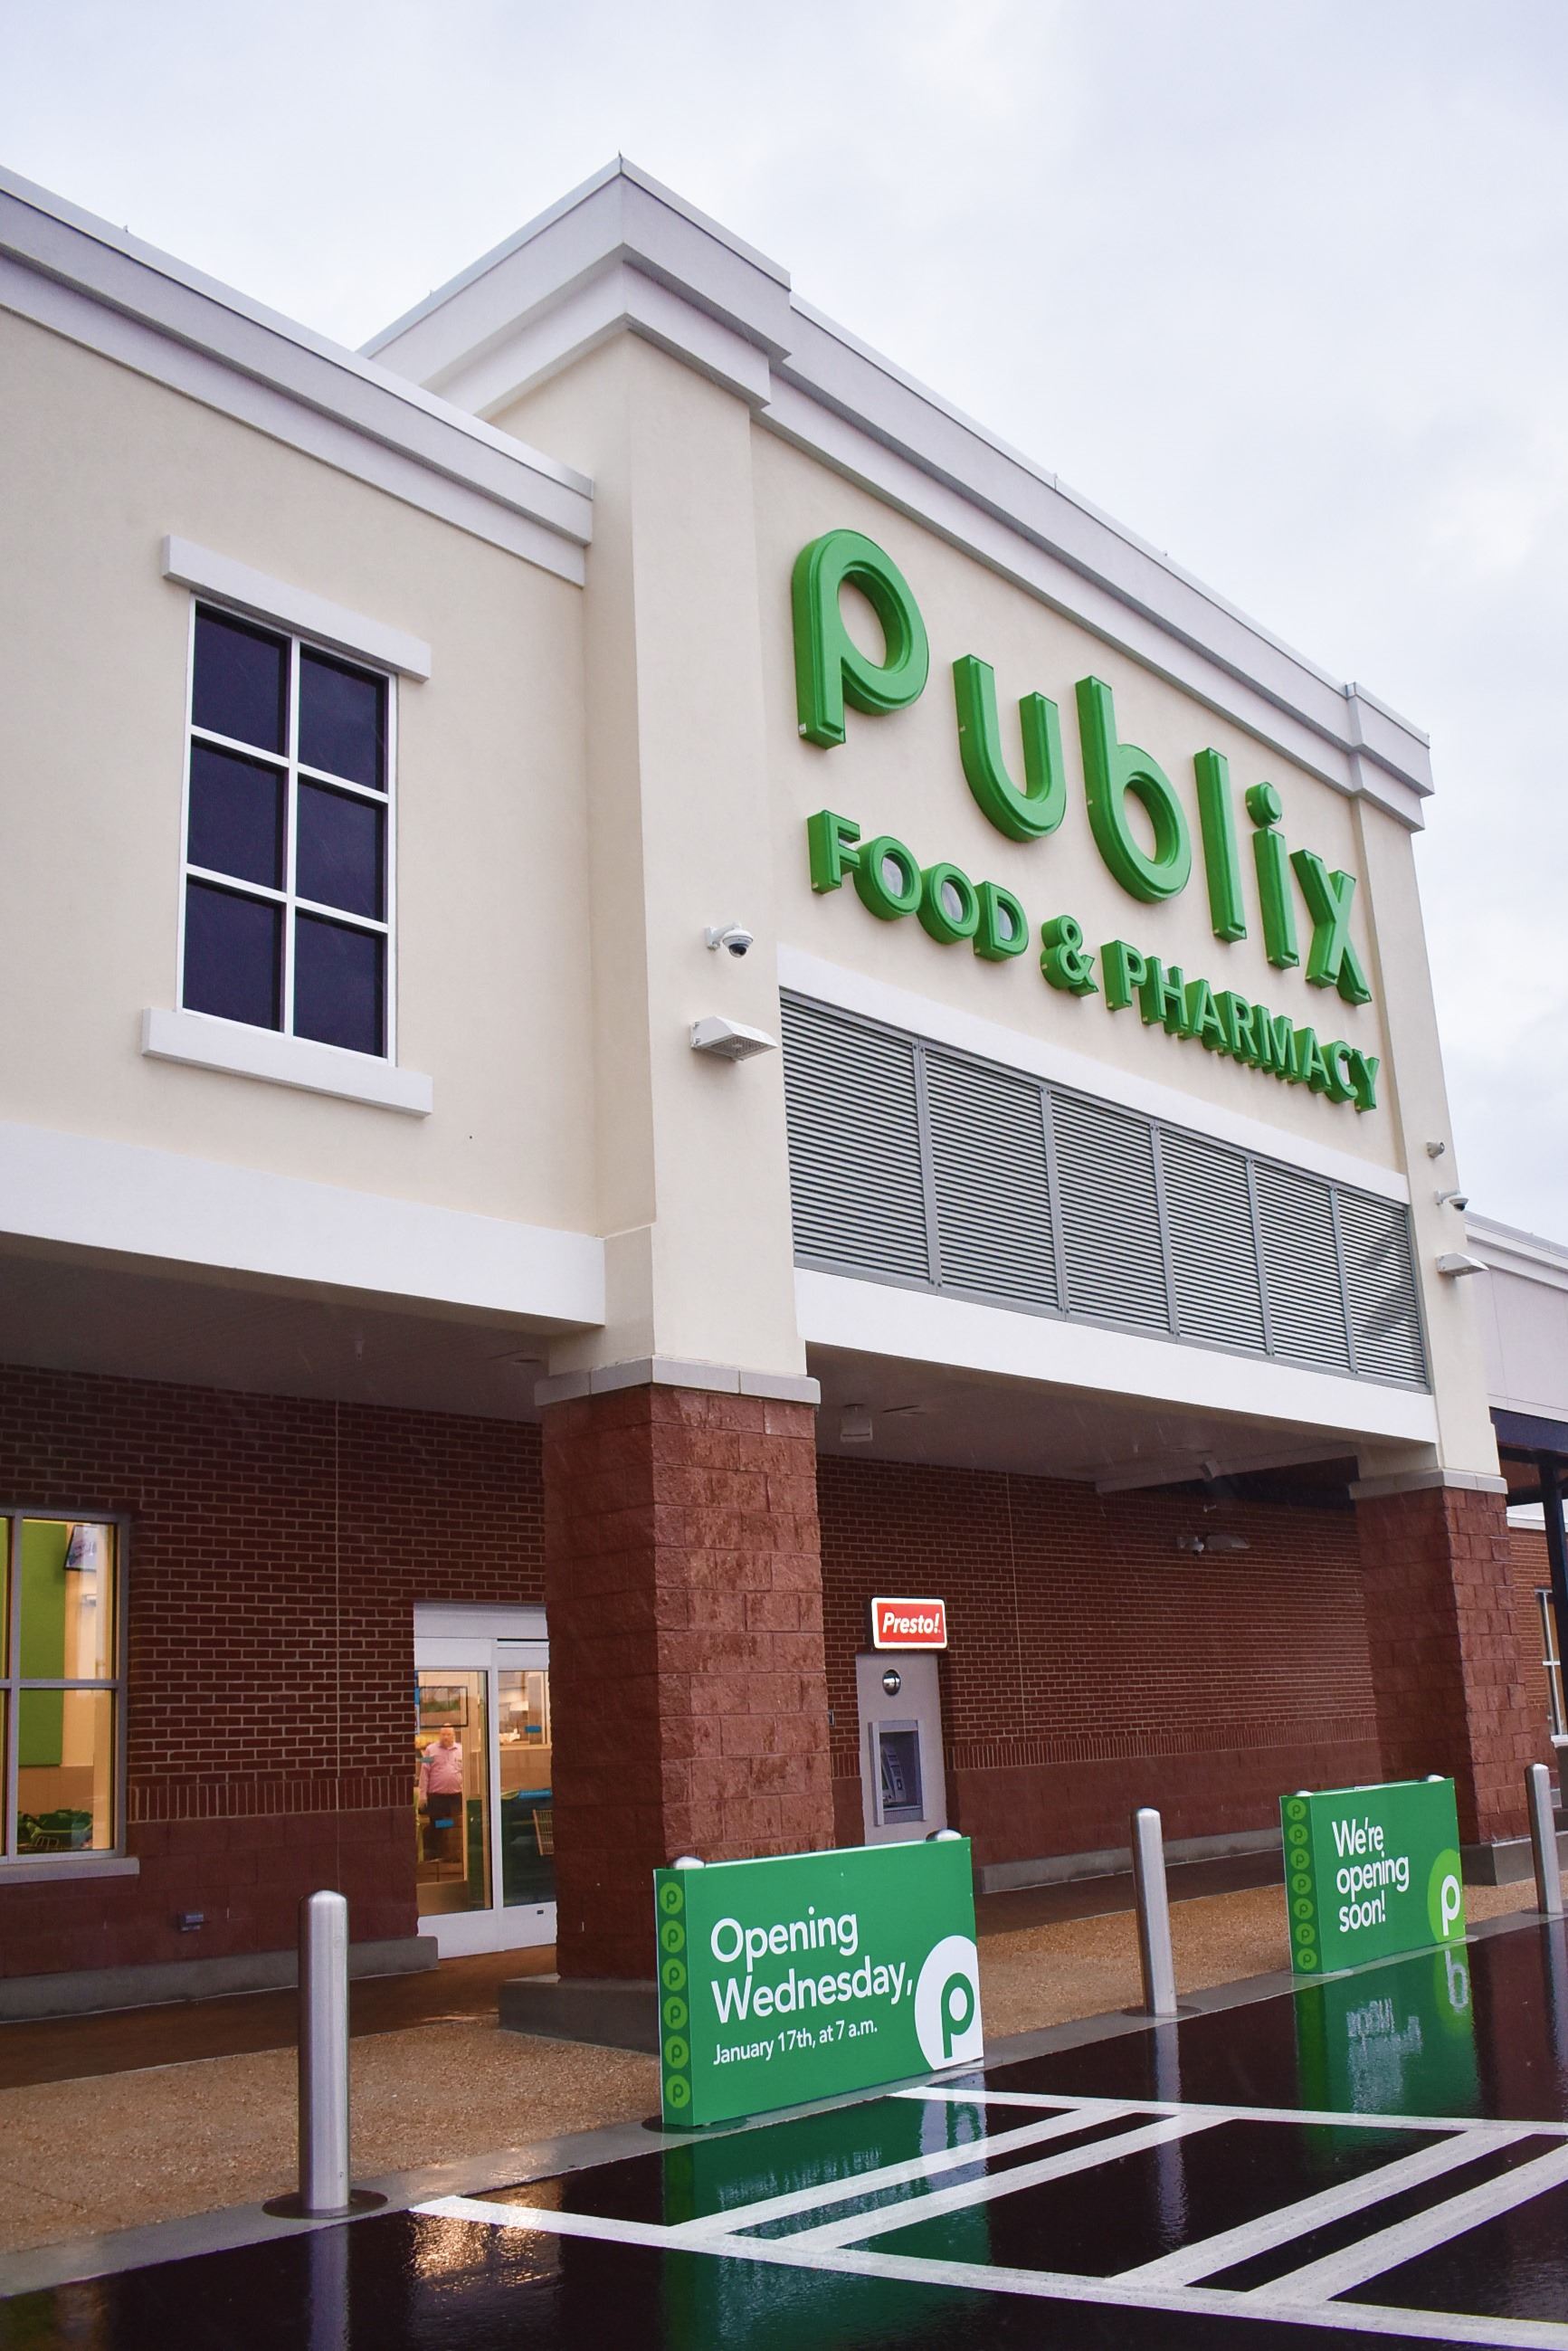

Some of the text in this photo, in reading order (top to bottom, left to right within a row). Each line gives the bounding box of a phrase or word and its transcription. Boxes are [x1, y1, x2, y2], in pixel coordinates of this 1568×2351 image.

[793, 528, 1372, 1005] Publix
[807, 809, 1380, 1112] FOOD & PHARMACY
[882, 1612, 940, 1634] Presto!
[1331, 1817, 1384, 1857] We're
[1336, 1851, 1410, 1903] opening
[1338, 1890, 1386, 1933] soon!
[710, 1906, 859, 1973] Opening
[710, 1955, 914, 2024] Wednesday,
[713, 2020, 878, 2065] January 17th, at 7 a.m.
